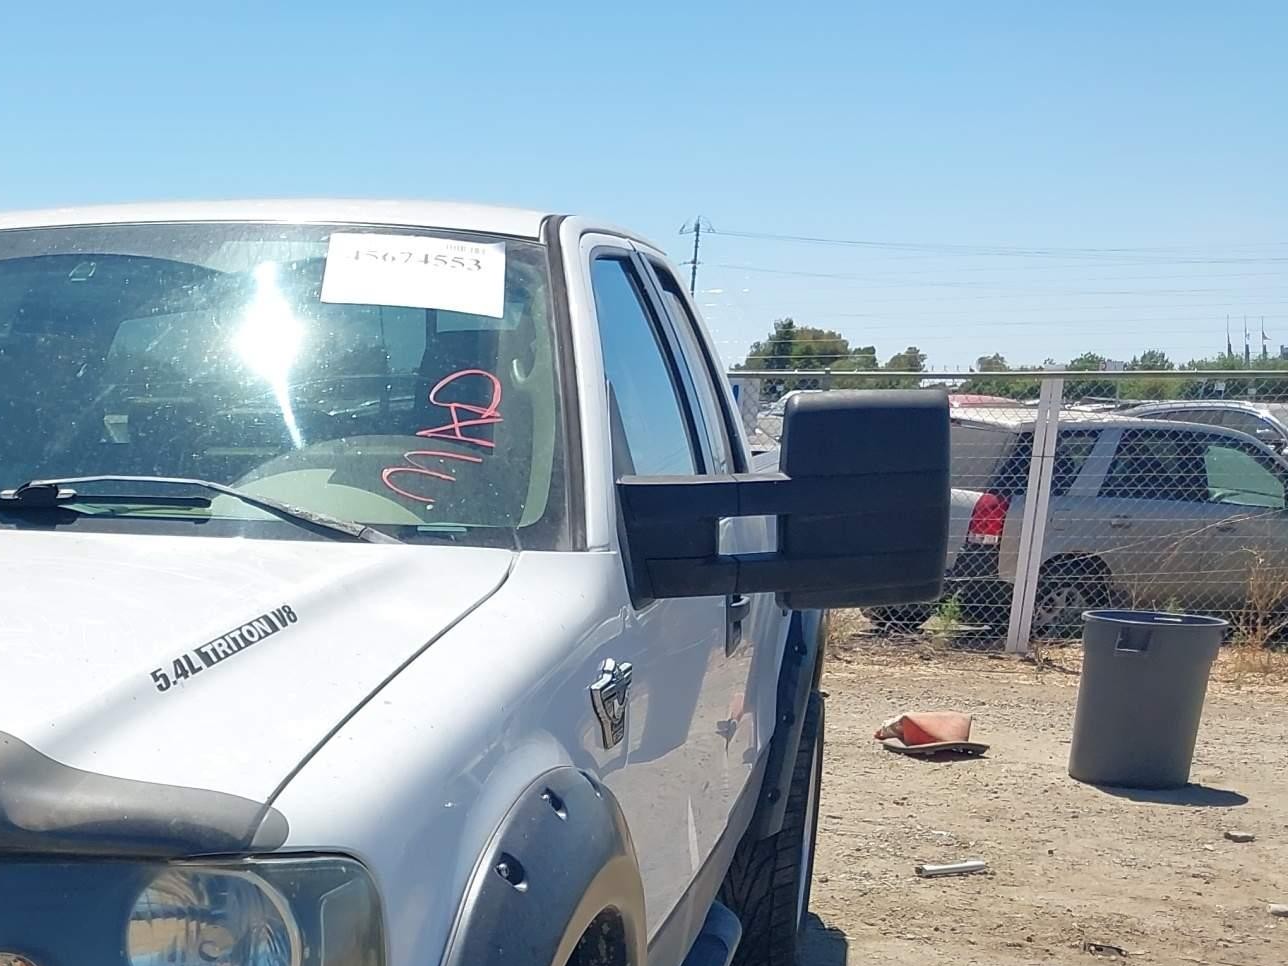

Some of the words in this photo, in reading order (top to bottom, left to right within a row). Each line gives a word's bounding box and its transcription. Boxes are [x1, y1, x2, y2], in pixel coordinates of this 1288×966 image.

[150, 654, 203, 692] 5.4L
[200, 617, 274, 664] TRITON
[271, 604, 298, 629] V8
